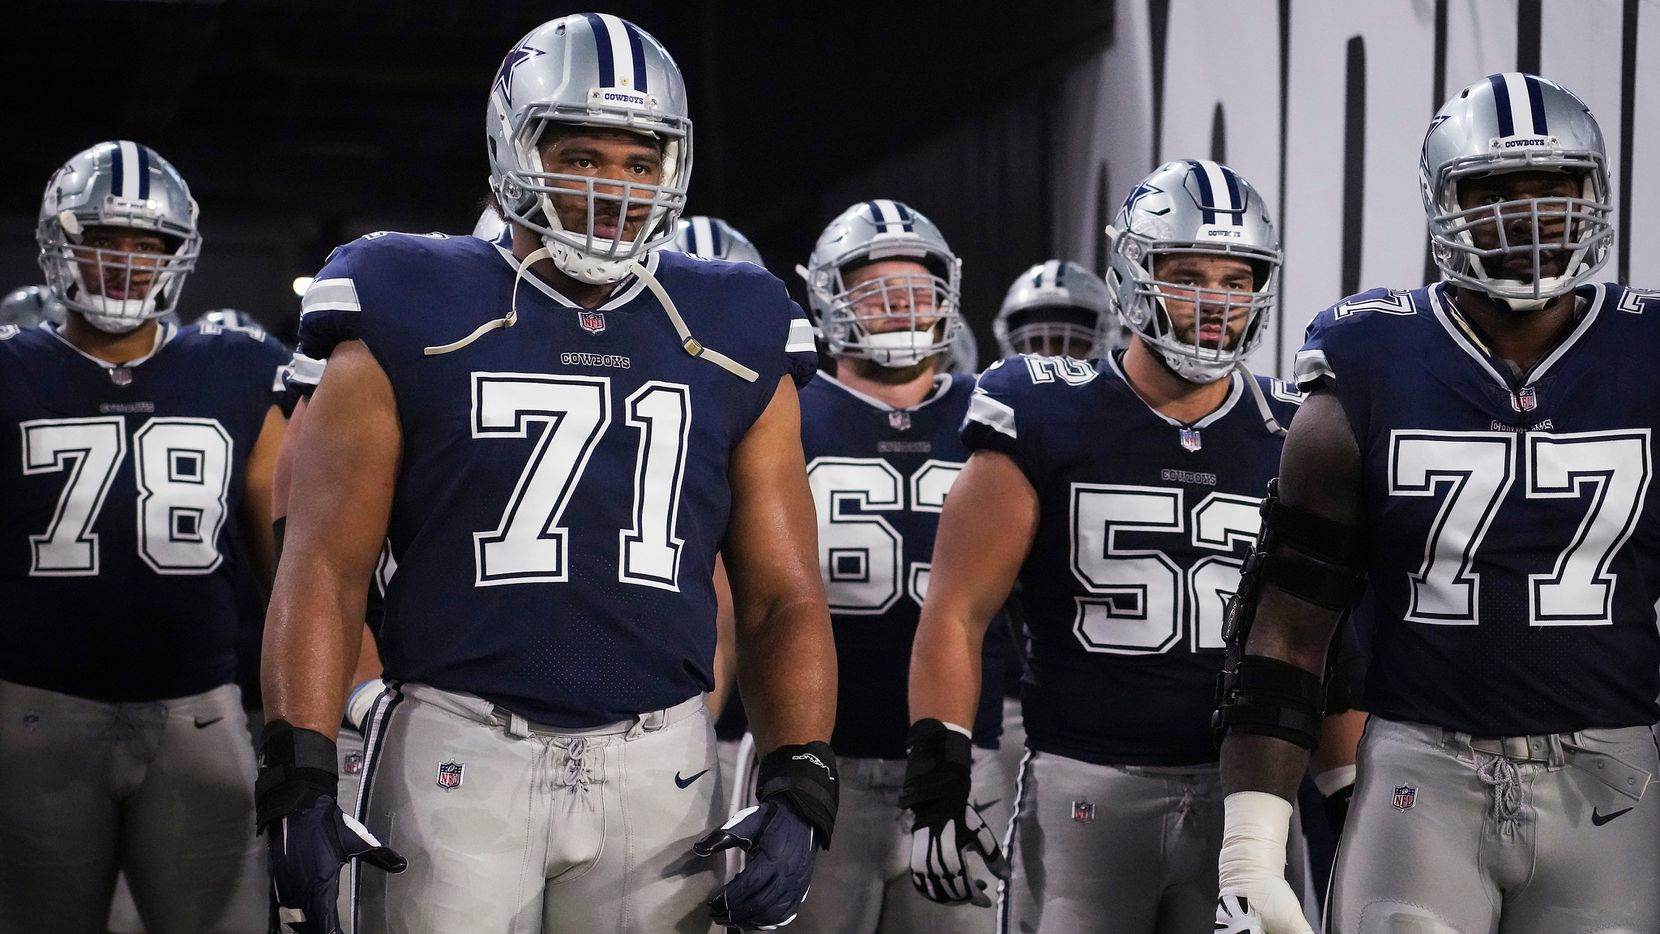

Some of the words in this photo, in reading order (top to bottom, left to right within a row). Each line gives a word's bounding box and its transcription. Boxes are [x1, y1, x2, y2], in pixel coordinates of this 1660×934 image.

[604, 92, 644, 105] COWBOYS
[1505, 139, 1545, 148] COWBOYS
[561, 352, 631, 369] COWBOYS
[19, 415, 234, 576] 78
[470, 371, 693, 593] 71
[1161, 469, 1217, 486] COWBOYS
[1068, 481, 1268, 656] 52
[1388, 427, 1653, 627] 77
